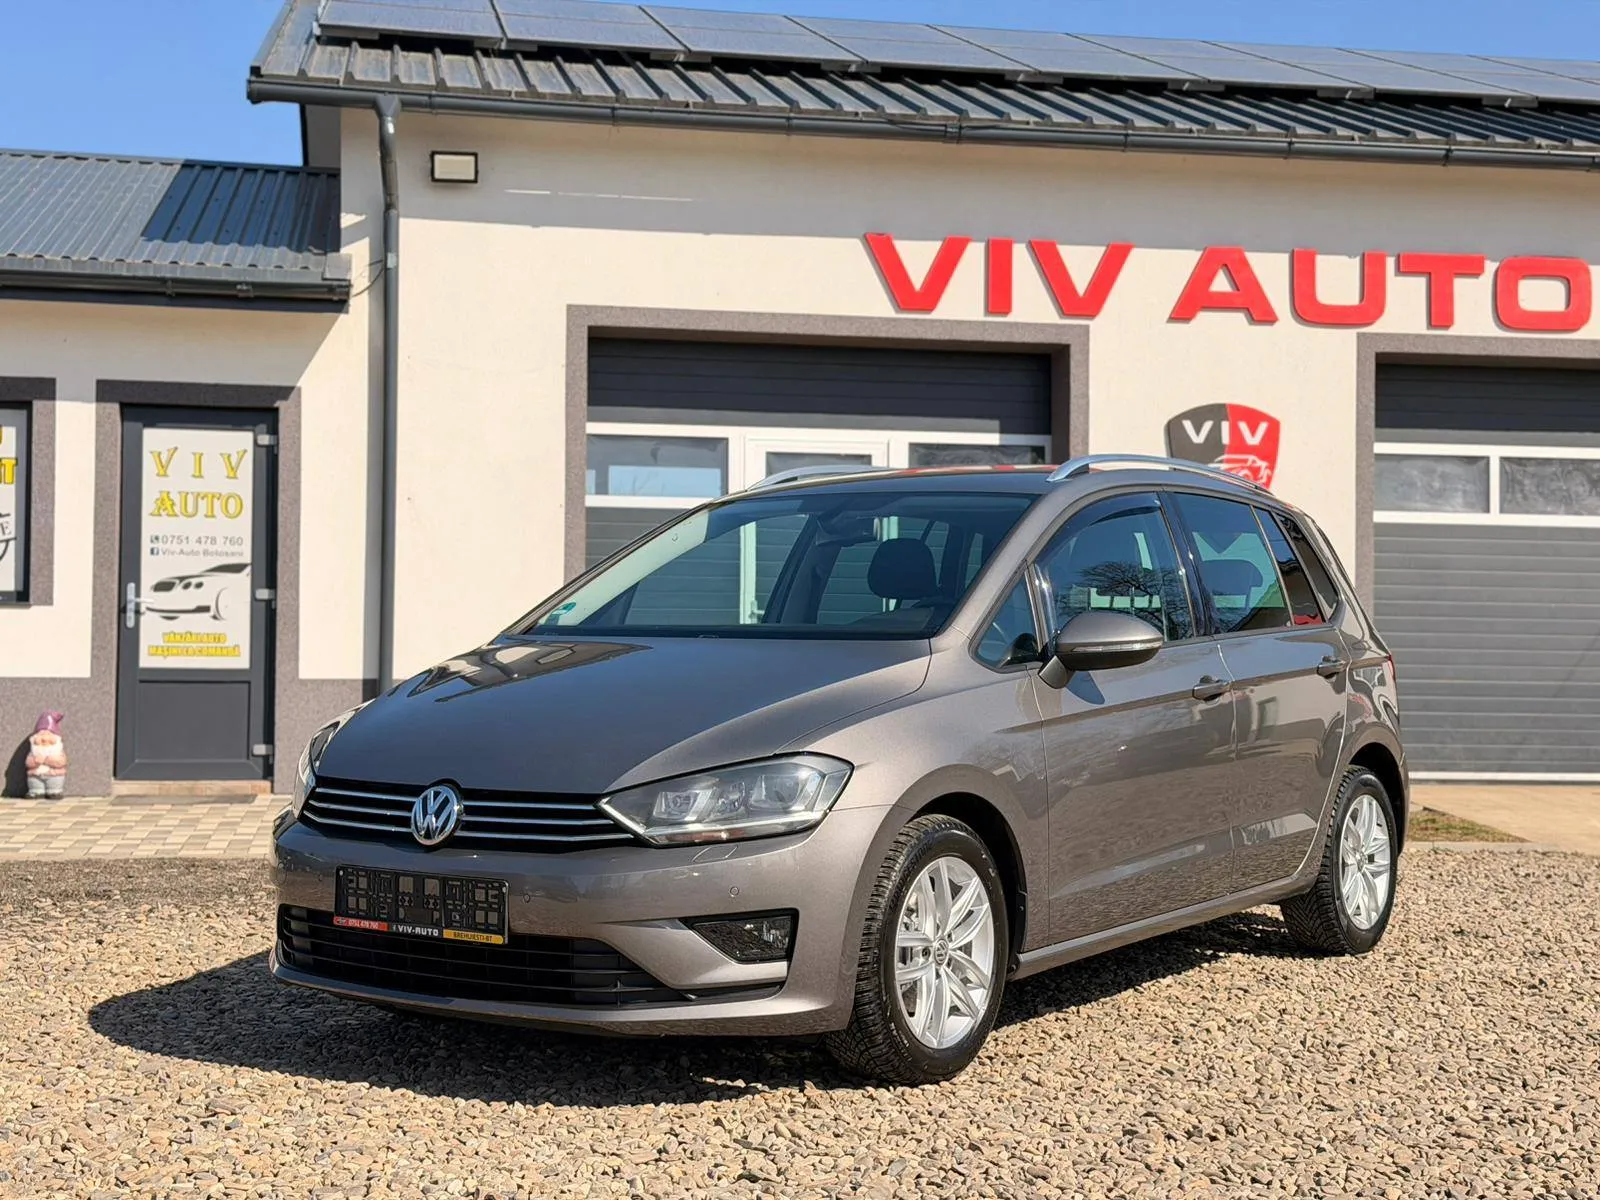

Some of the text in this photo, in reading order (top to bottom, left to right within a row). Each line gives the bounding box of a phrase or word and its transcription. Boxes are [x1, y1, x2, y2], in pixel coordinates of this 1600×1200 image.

[864, 232, 1592, 332] VIV AUTO
[1181, 419, 1270, 446] VIV
[149, 490, 245, 519] AUTO
[161, 533, 244, 547] 0751 478 760
